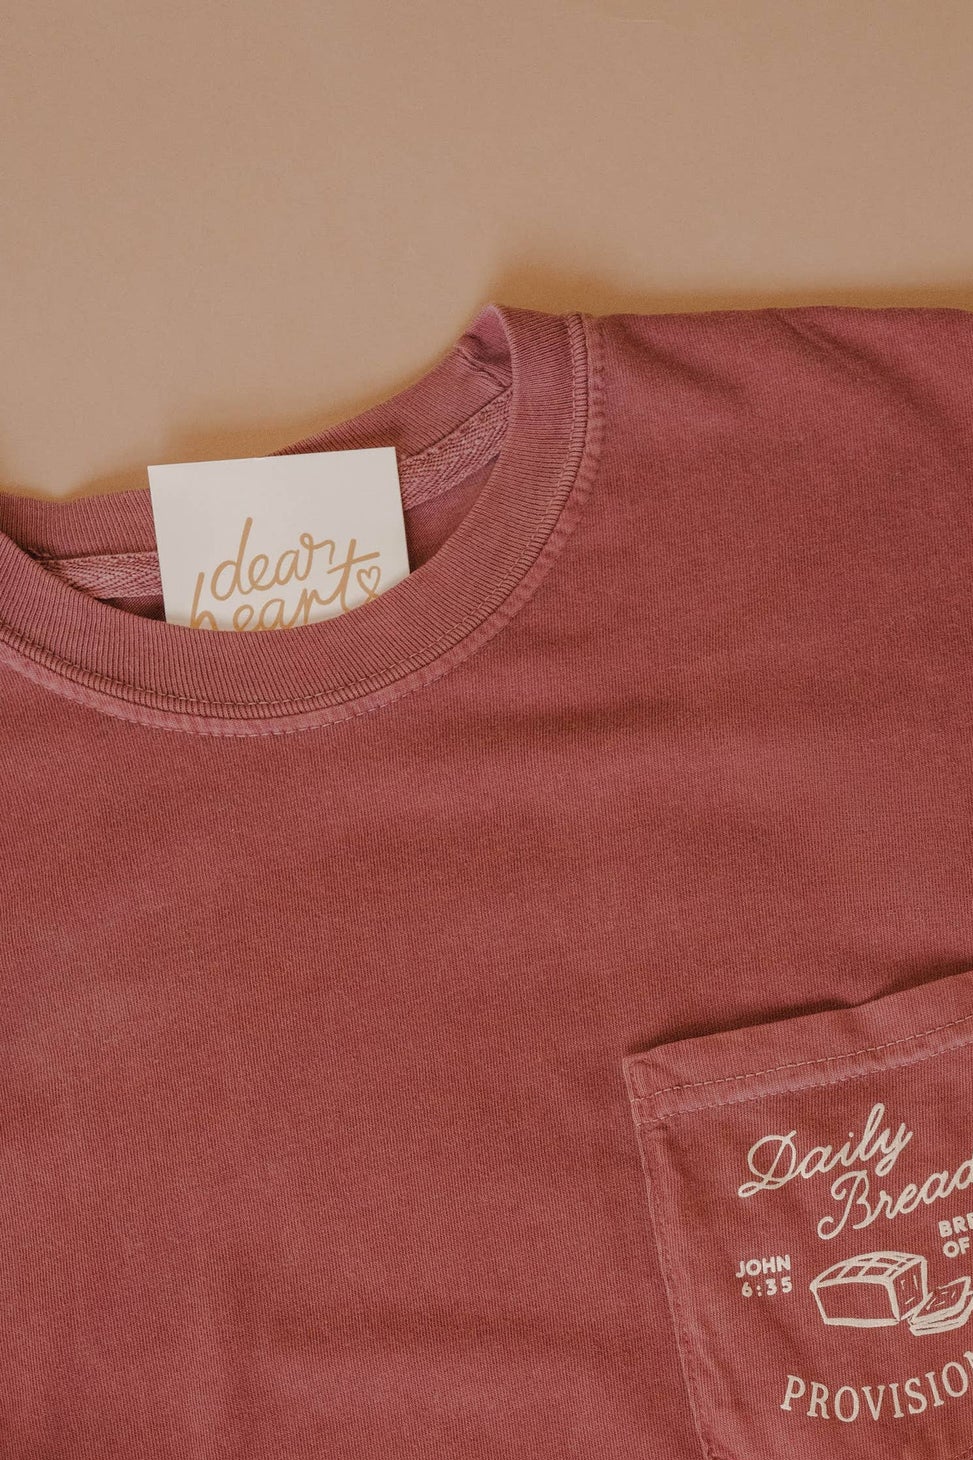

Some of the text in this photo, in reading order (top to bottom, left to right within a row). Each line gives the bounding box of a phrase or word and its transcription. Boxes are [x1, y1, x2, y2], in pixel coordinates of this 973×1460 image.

[189, 538, 381, 631] heart
[210, 516, 336, 601] dear
[738, 1102, 914, 1198] Daily
[735, 1253, 792, 1279] JOHN
[942, 1238, 971, 1258] OF
[741, 1276, 793, 1298] 6:35
